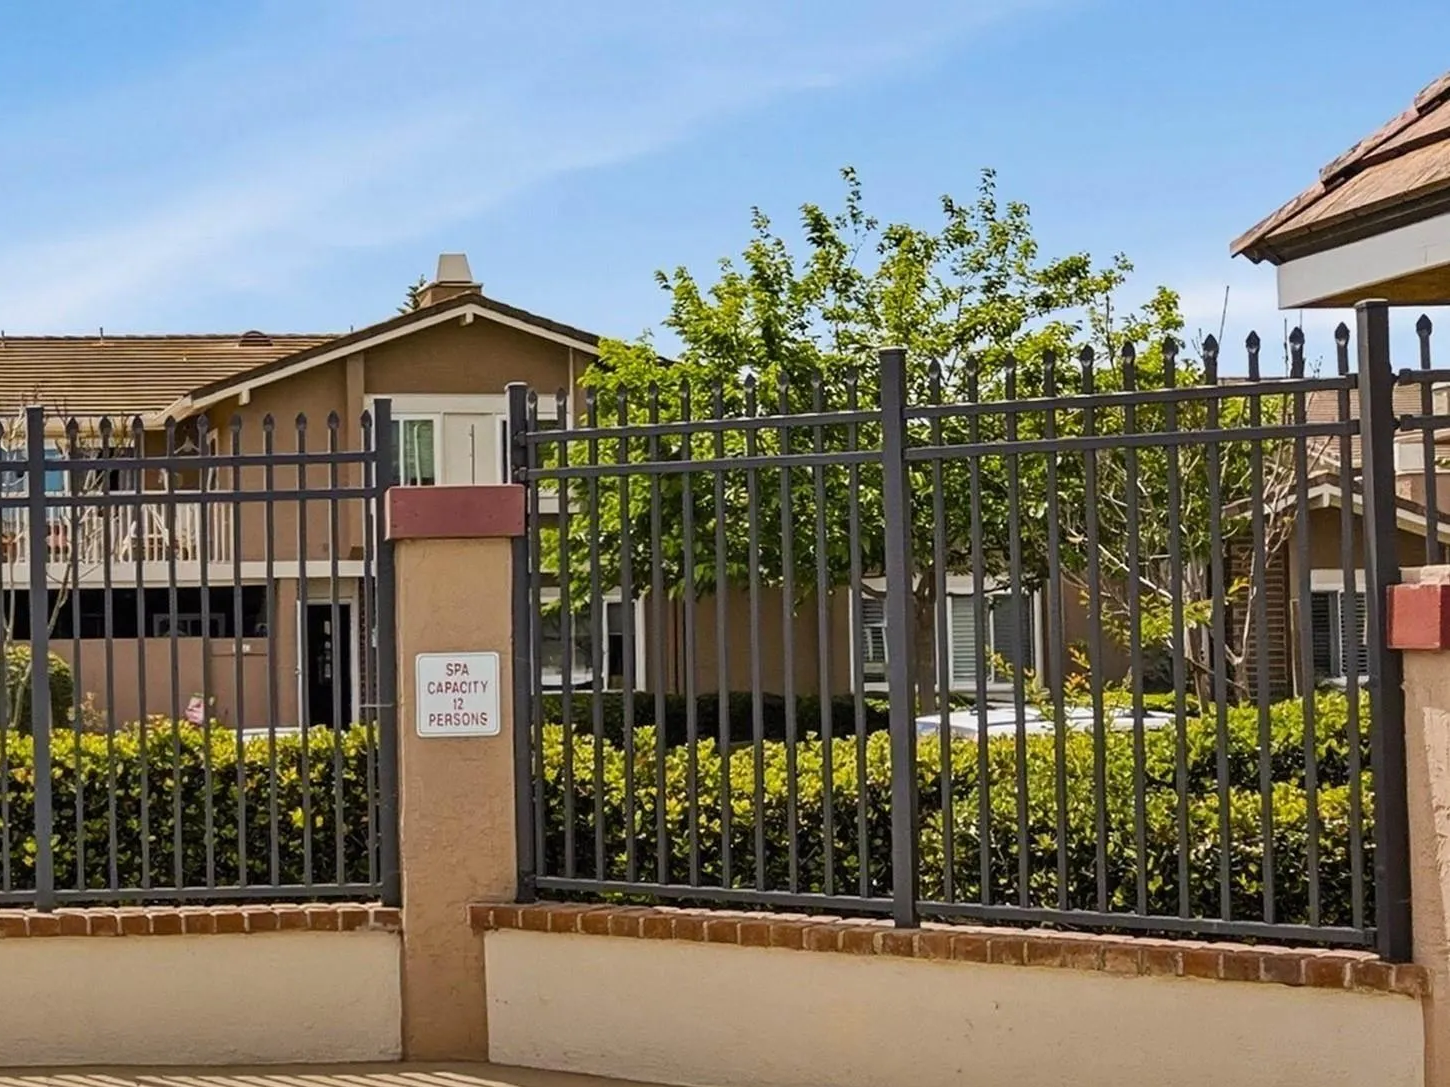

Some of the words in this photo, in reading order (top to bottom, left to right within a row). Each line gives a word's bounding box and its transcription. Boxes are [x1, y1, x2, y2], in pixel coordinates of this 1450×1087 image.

[445, 663, 470, 677] SPA
[427, 681, 488, 695] CAPACITY
[452, 698, 465, 711] 12
[428, 712, 489, 727] PERSONS
